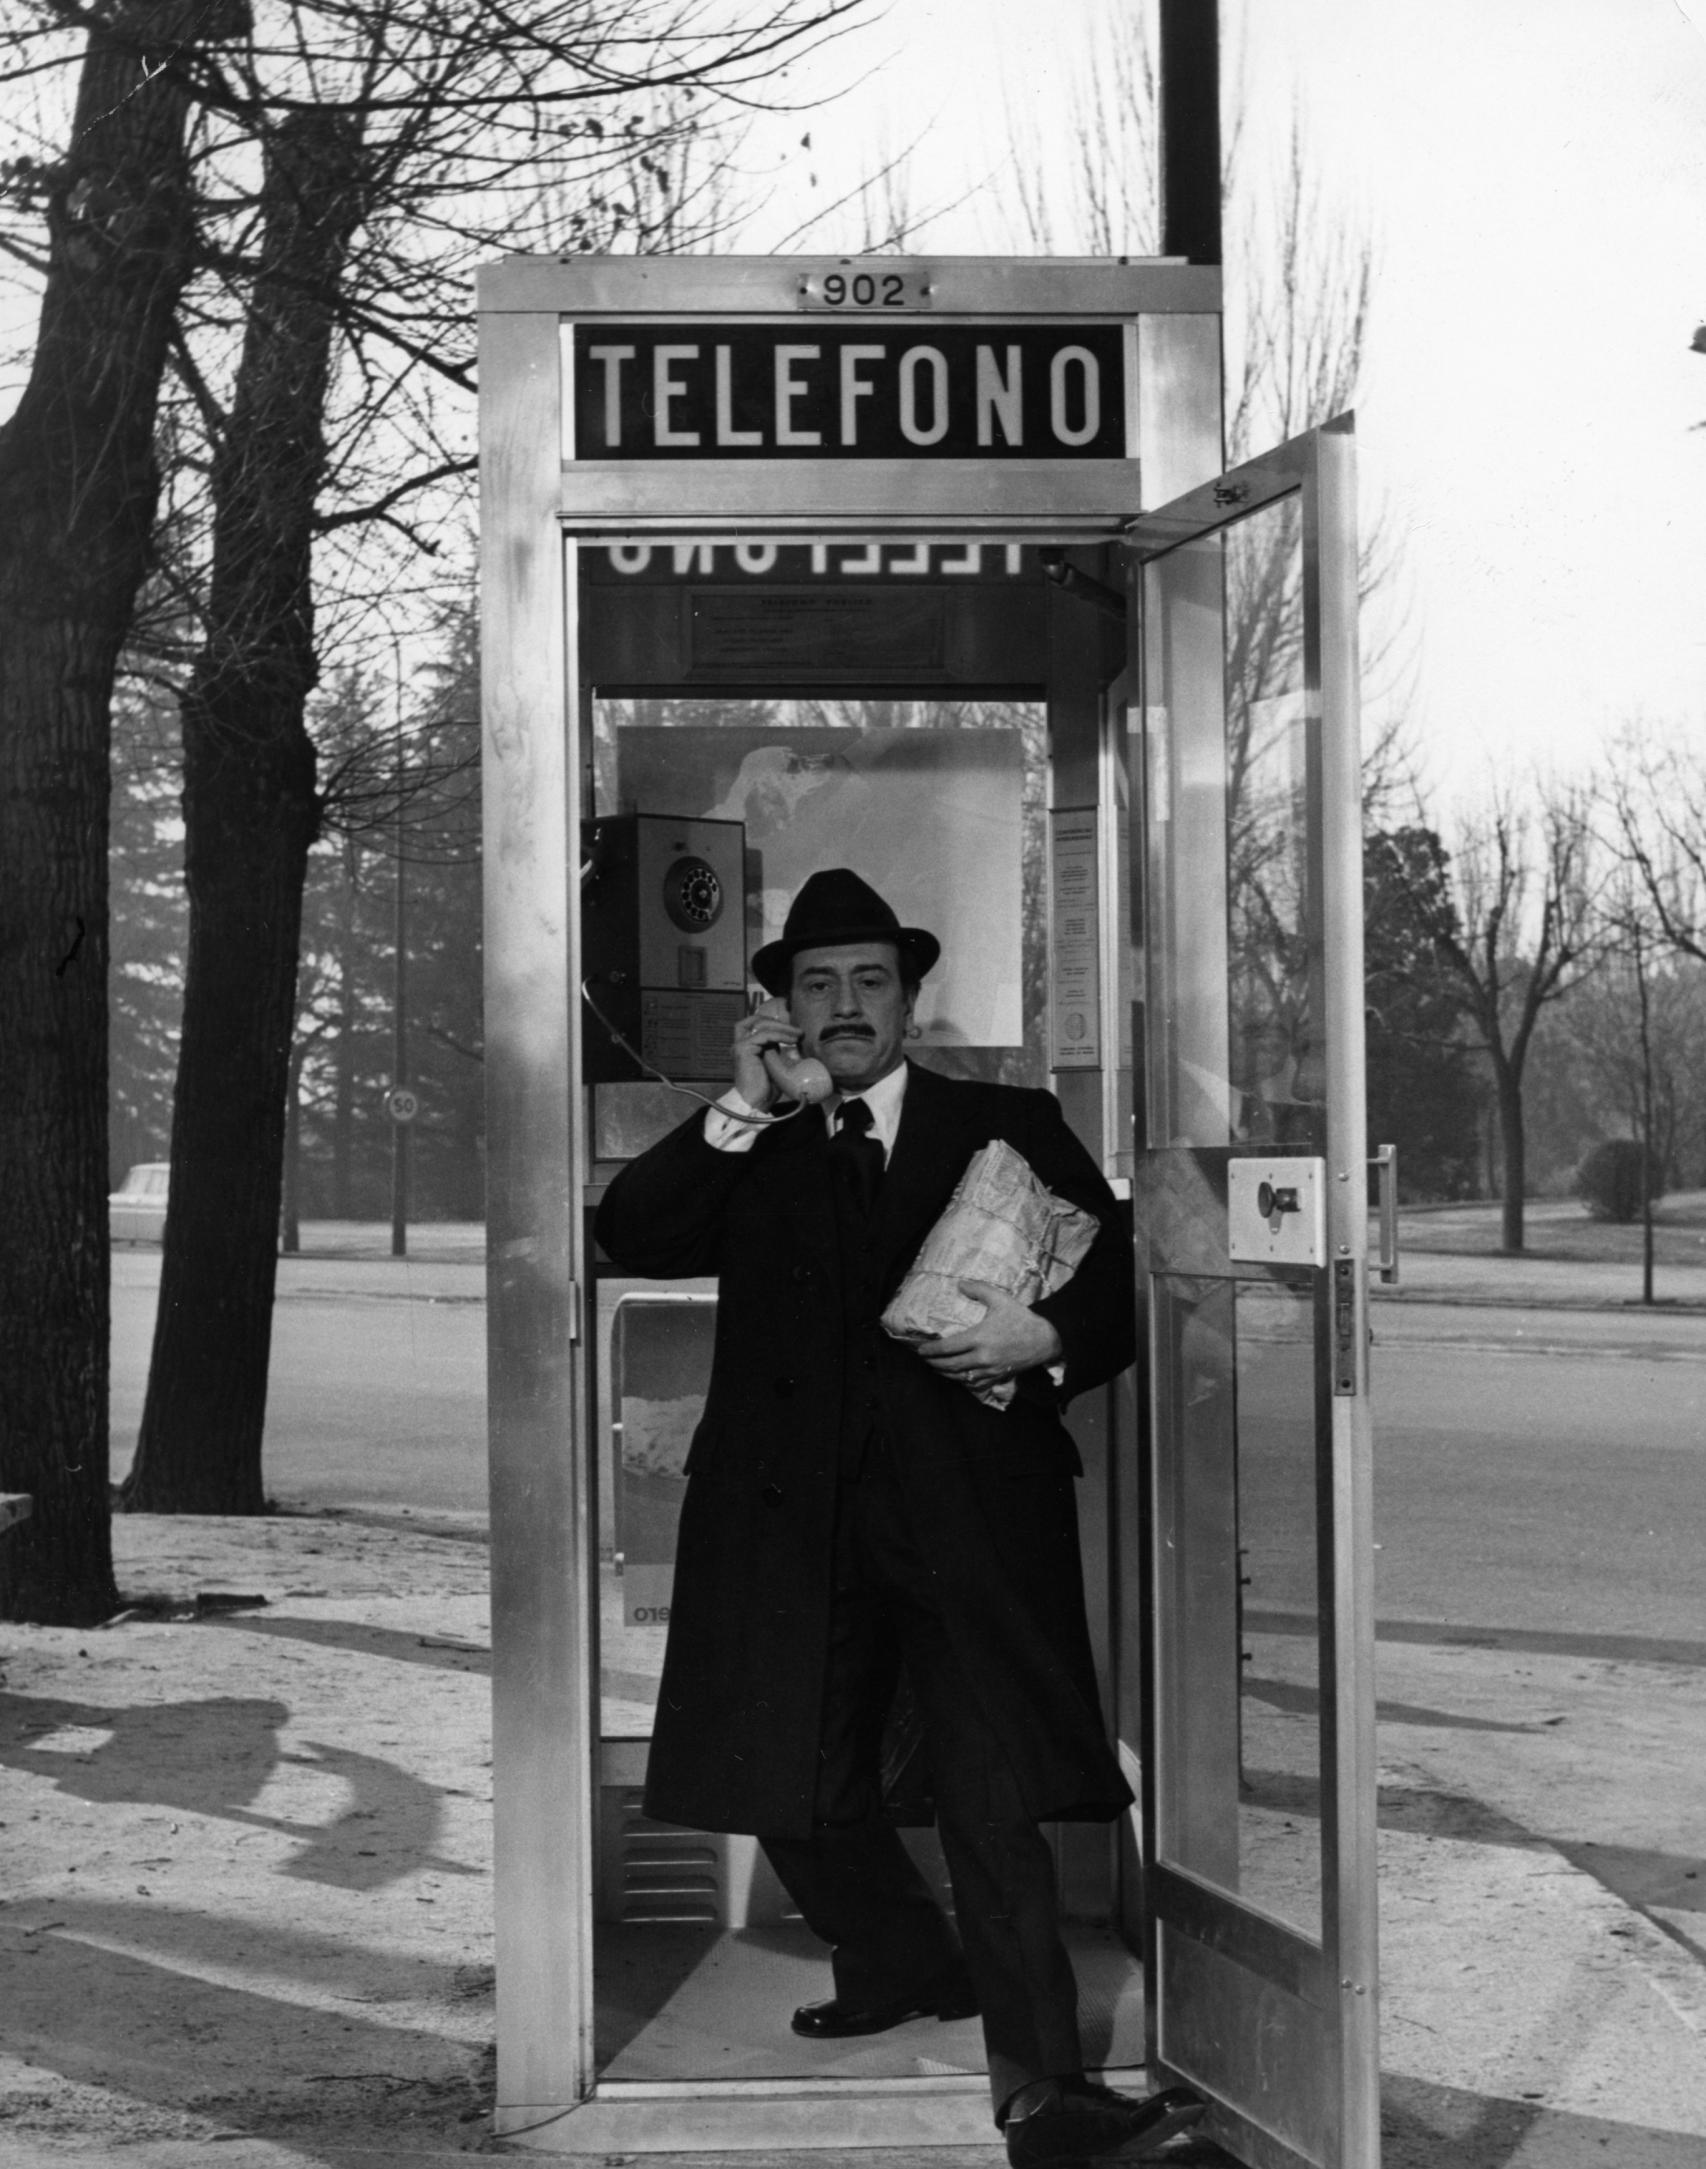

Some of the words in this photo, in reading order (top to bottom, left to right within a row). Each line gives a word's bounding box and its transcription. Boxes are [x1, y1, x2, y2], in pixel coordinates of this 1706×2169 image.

[823, 273, 906, 307] 902
[588, 344, 1101, 447] TELEFONO
[393, 1097, 414, 1113] 50
